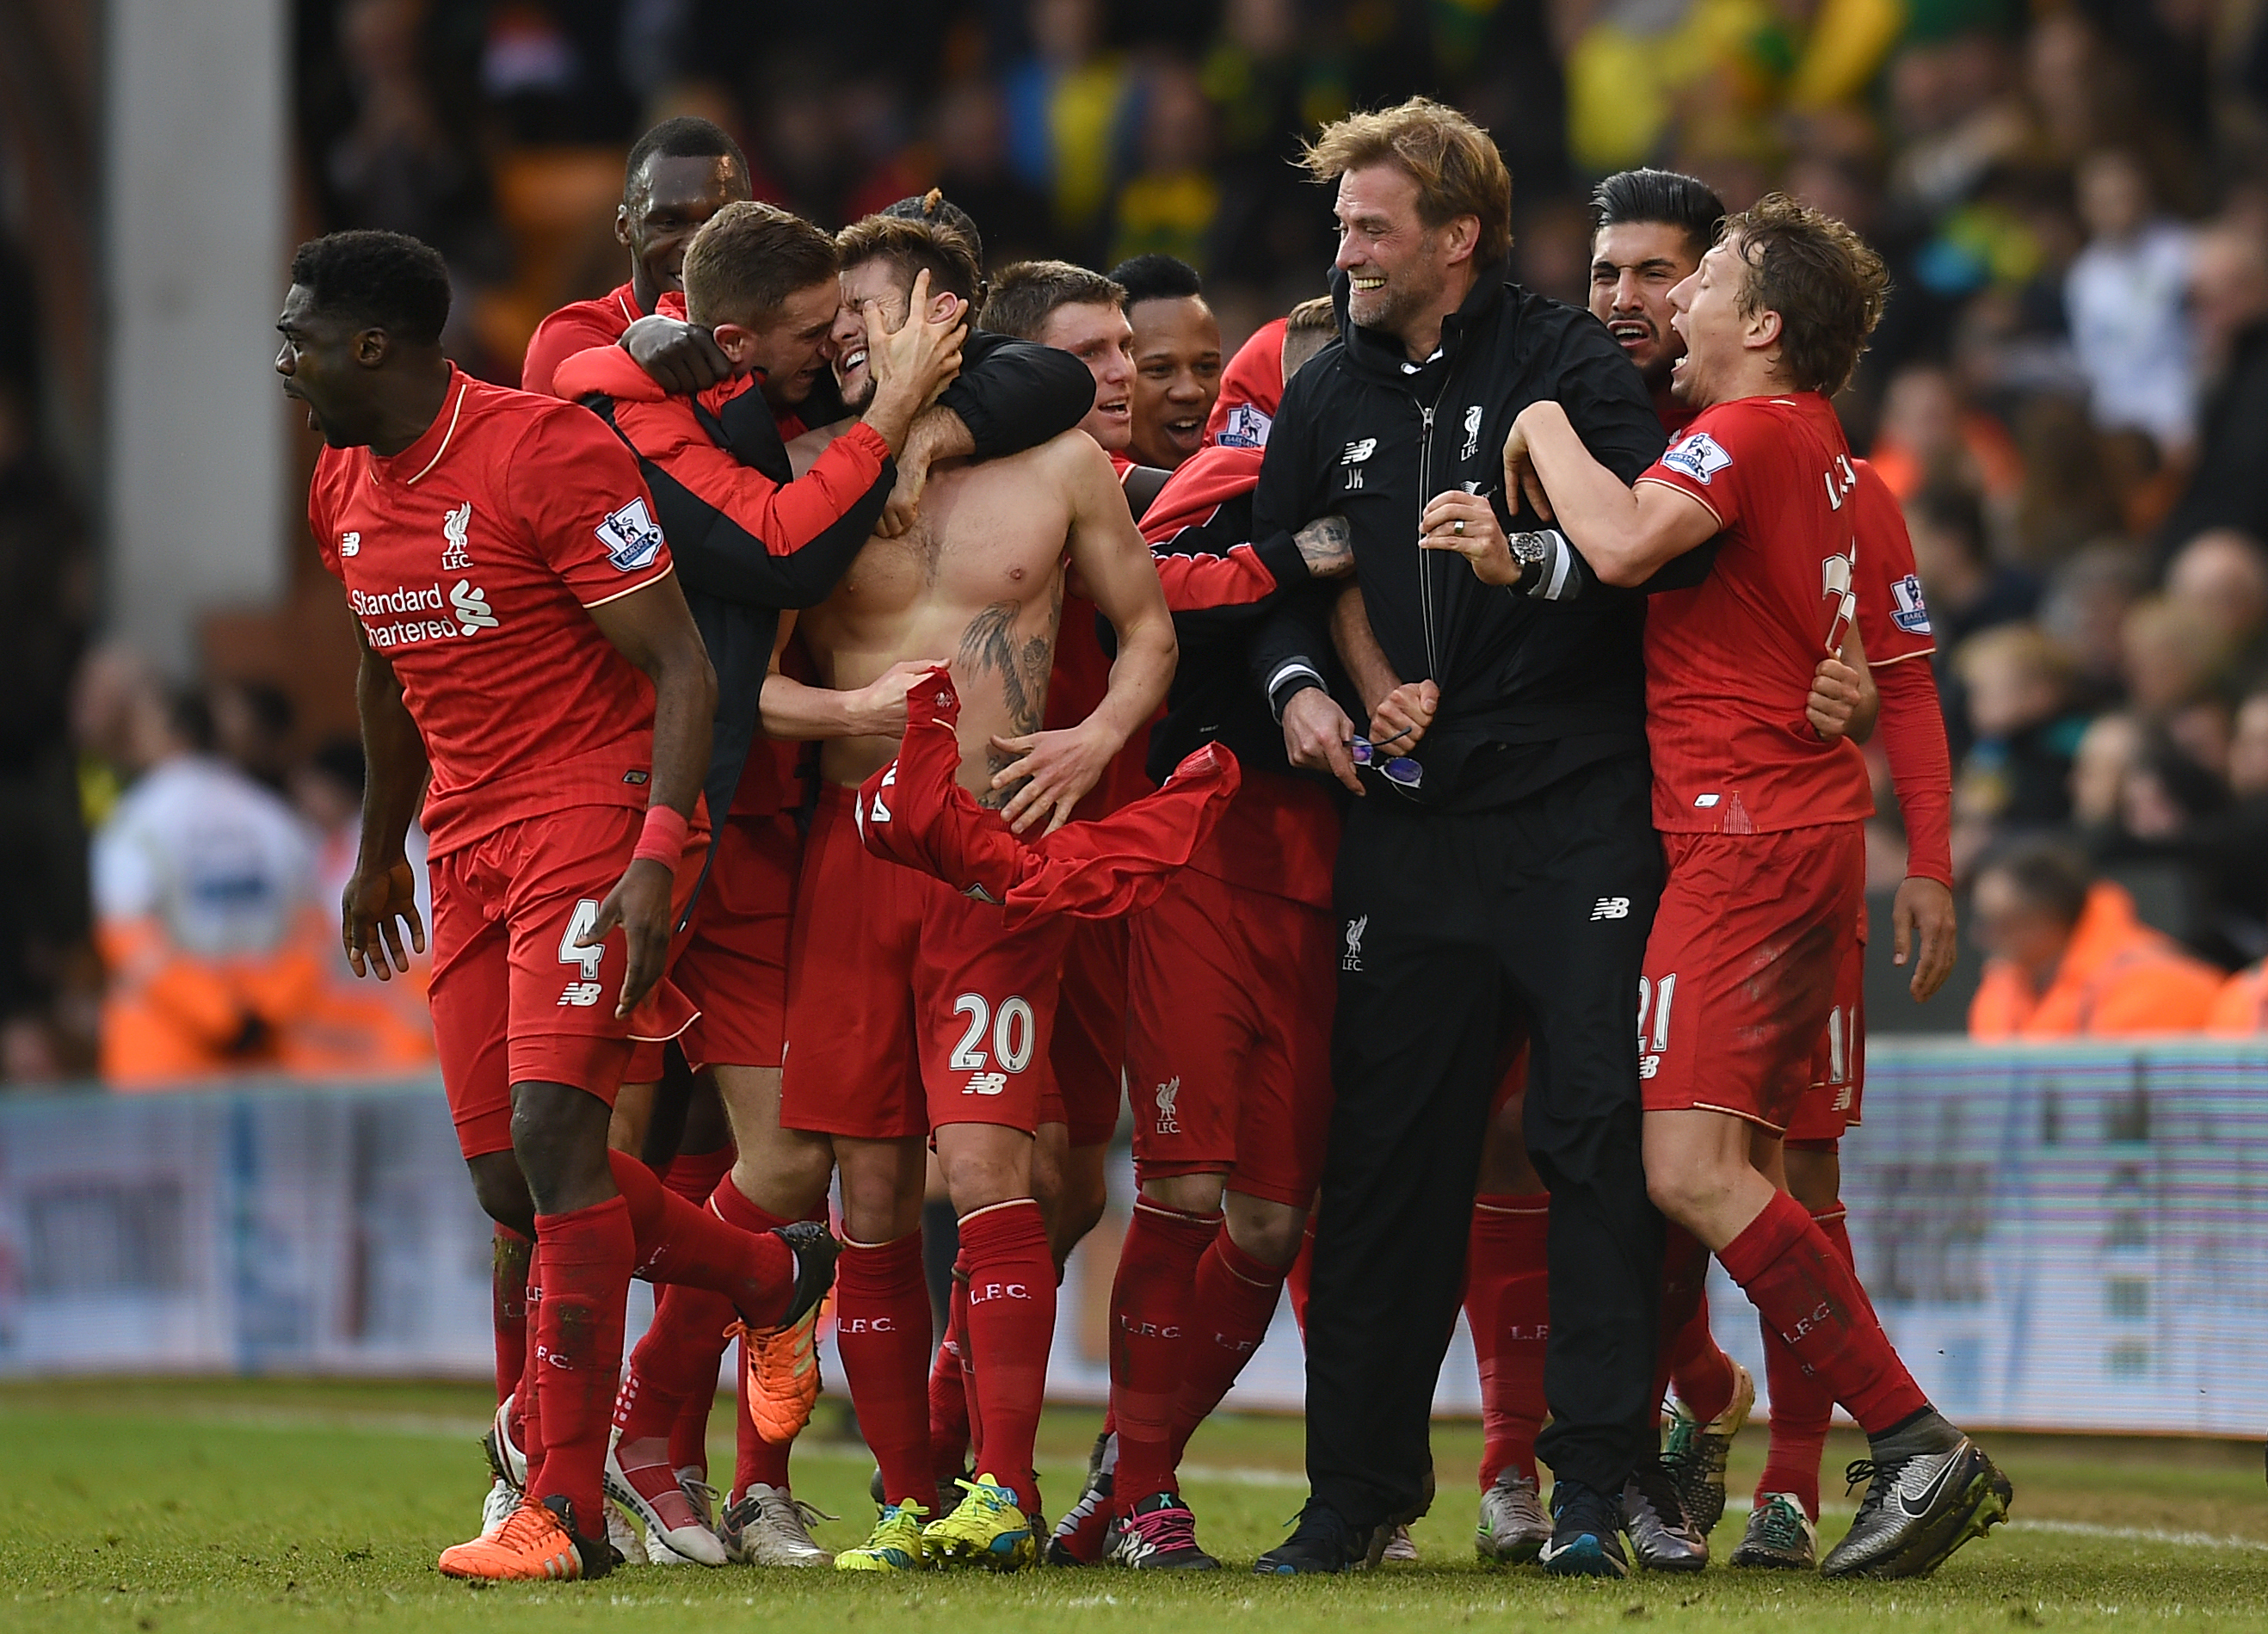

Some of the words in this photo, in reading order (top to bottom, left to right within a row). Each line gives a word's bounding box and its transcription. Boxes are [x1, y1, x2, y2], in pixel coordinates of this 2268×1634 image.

[1344, 468, 1364, 490] JK
[620, 536, 648, 562] BARCLAYS
[351, 583, 444, 616] Standard
[558, 898, 605, 980] 4
[948, 992, 1035, 1073] 20
